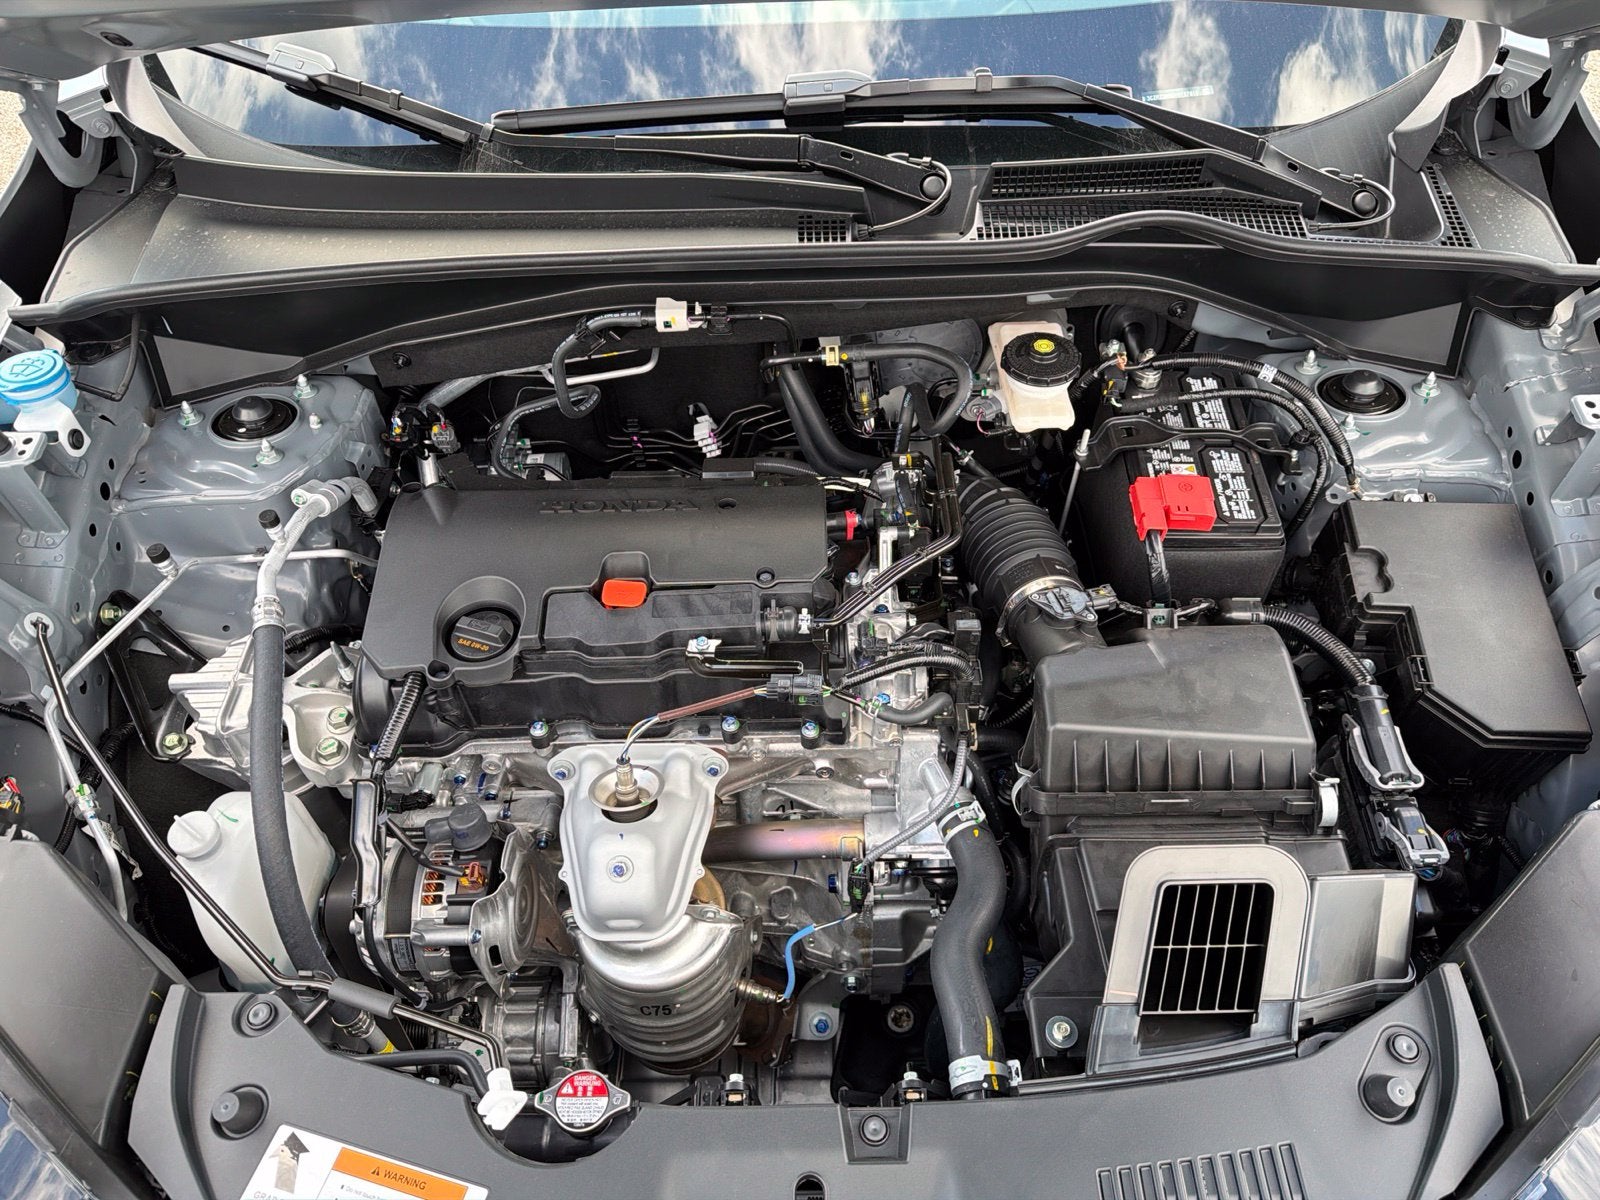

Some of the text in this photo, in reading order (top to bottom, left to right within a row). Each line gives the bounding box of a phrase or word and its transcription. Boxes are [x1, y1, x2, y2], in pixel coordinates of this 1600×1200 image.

[538, 499, 700, 514] HONDA
[457, 638, 471, 647] SAE
[640, 1004, 673, 1016] C75
[383, 1168, 428, 1191] WARNING
